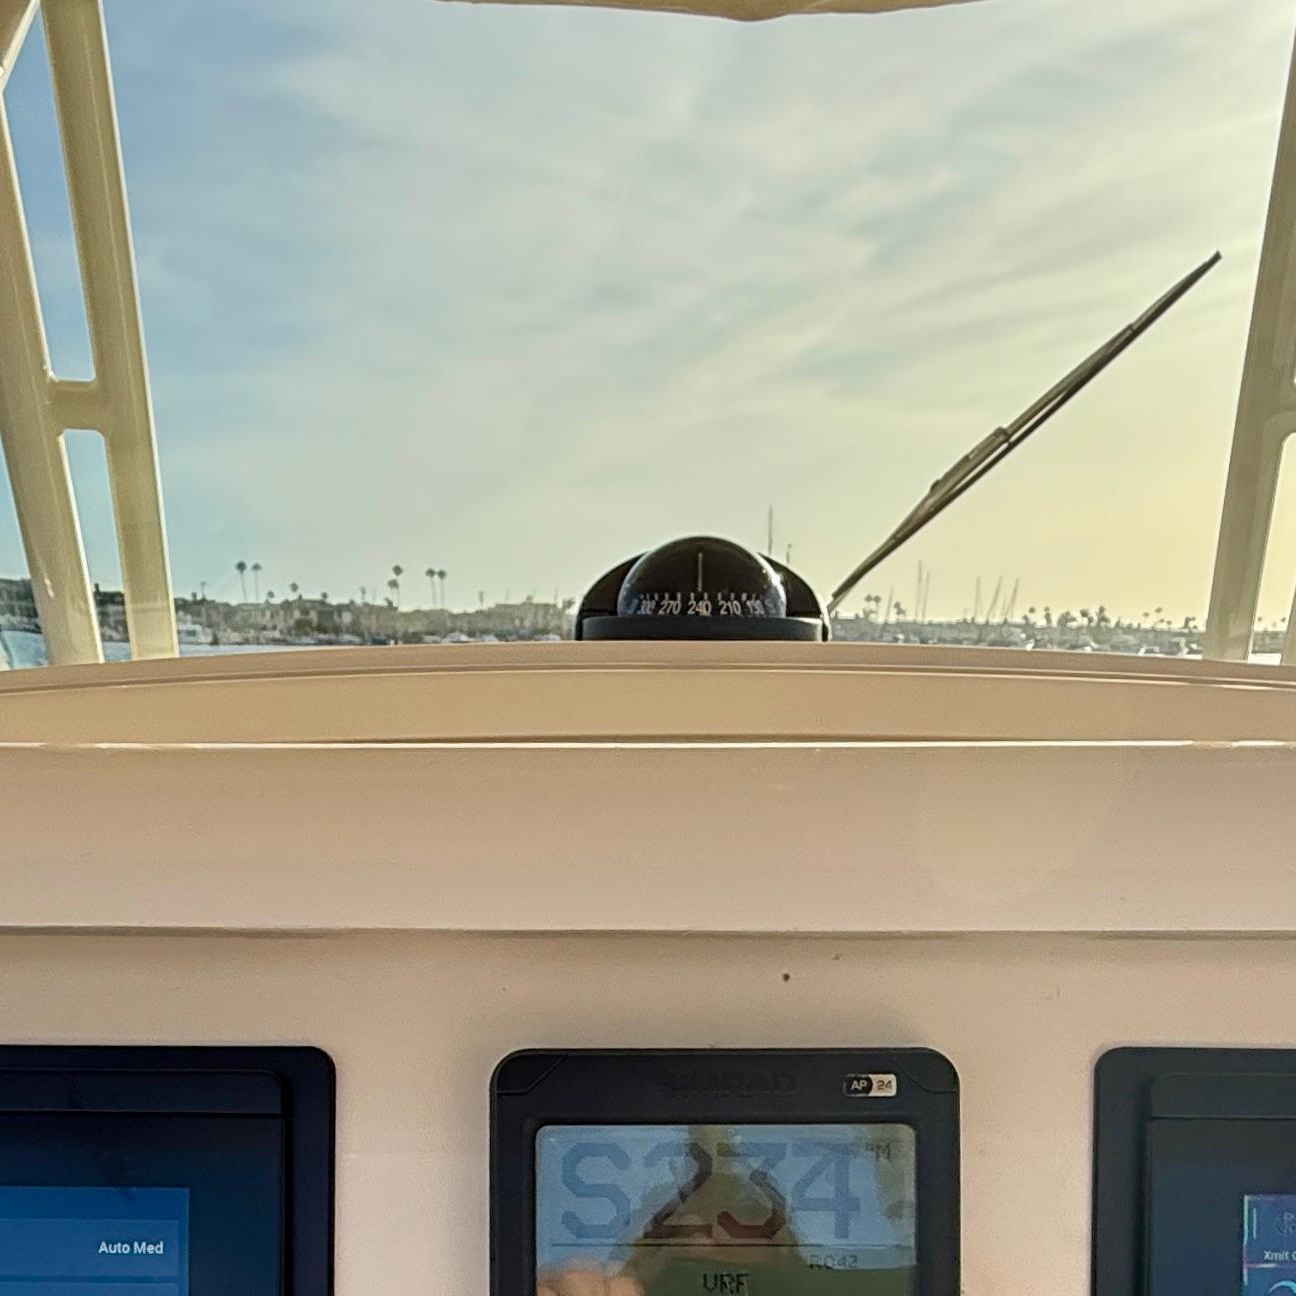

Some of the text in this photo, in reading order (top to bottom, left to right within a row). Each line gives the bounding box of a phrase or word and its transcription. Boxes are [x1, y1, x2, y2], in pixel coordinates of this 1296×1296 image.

[658, 599, 682, 615] 270
[687, 599, 712, 616] 240
[719, 599, 742, 616] 210
[850, 1079, 893, 1090] AP 24
[560, 1142, 861, 1240] S234
[98, 1240, 164, 1255] Auto Med
